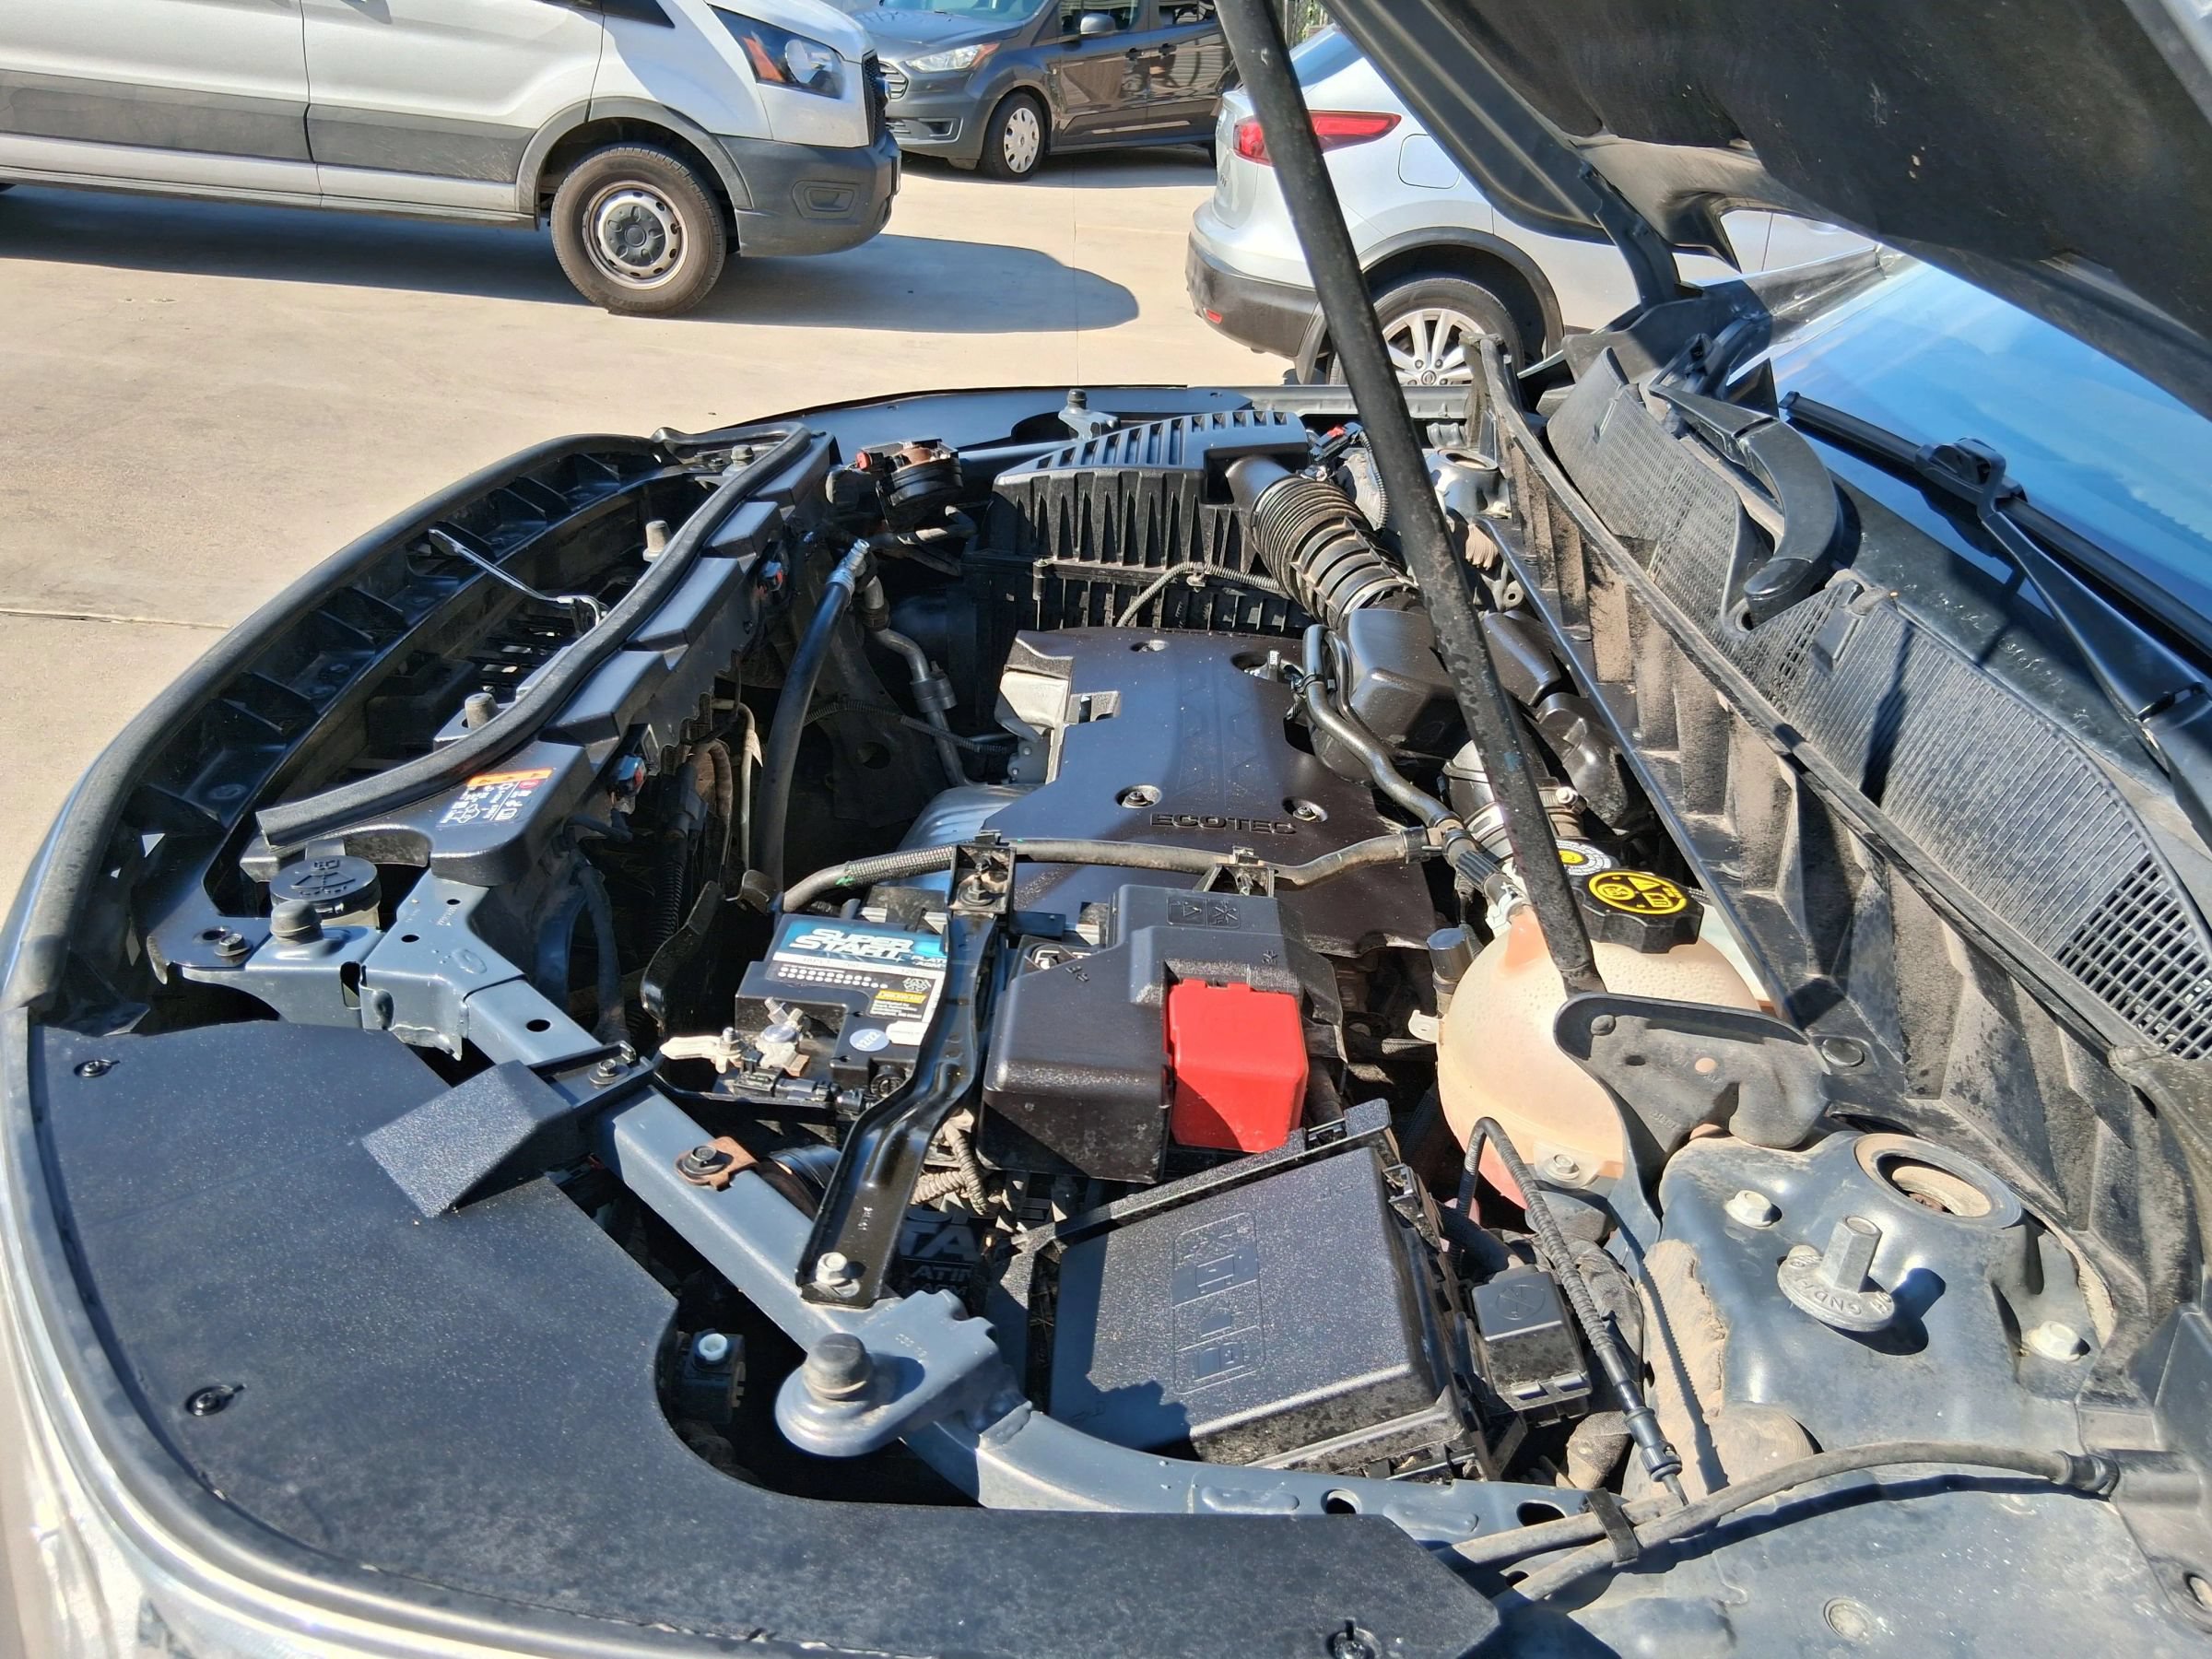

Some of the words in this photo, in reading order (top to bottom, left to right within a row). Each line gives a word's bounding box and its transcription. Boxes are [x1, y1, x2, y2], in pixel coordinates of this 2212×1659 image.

[1150, 813, 1297, 835] ECOTEC
[789, 935, 907, 962] START
[812, 928, 914, 951] SUPER
